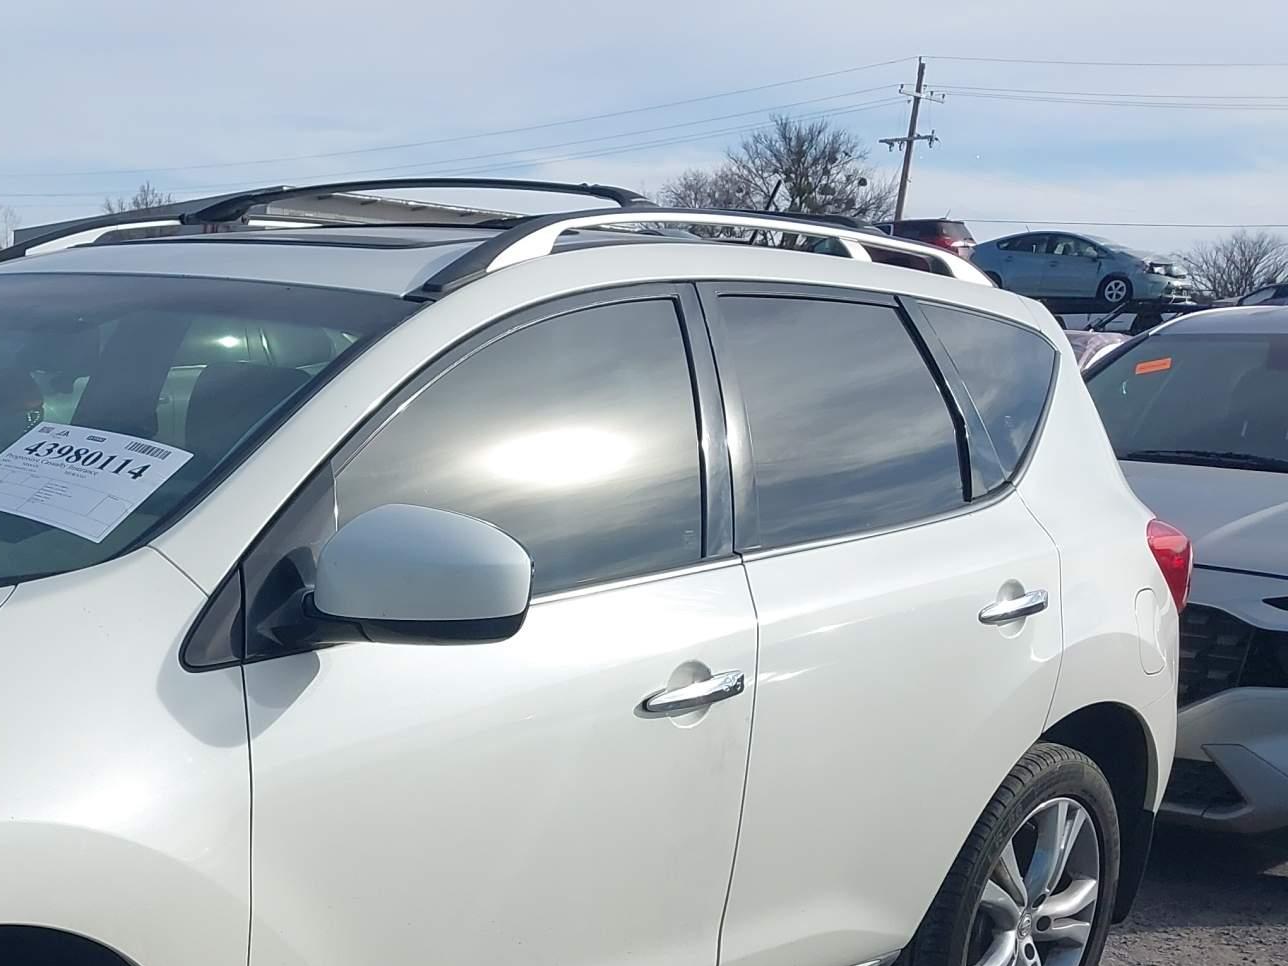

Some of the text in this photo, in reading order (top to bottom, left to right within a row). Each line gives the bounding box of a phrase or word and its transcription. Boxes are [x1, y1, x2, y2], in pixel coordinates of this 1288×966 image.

[23, 440, 151, 480] 43980114
[40, 459, 66, 468] Casualty
[66, 464, 100, 476] Insurance
